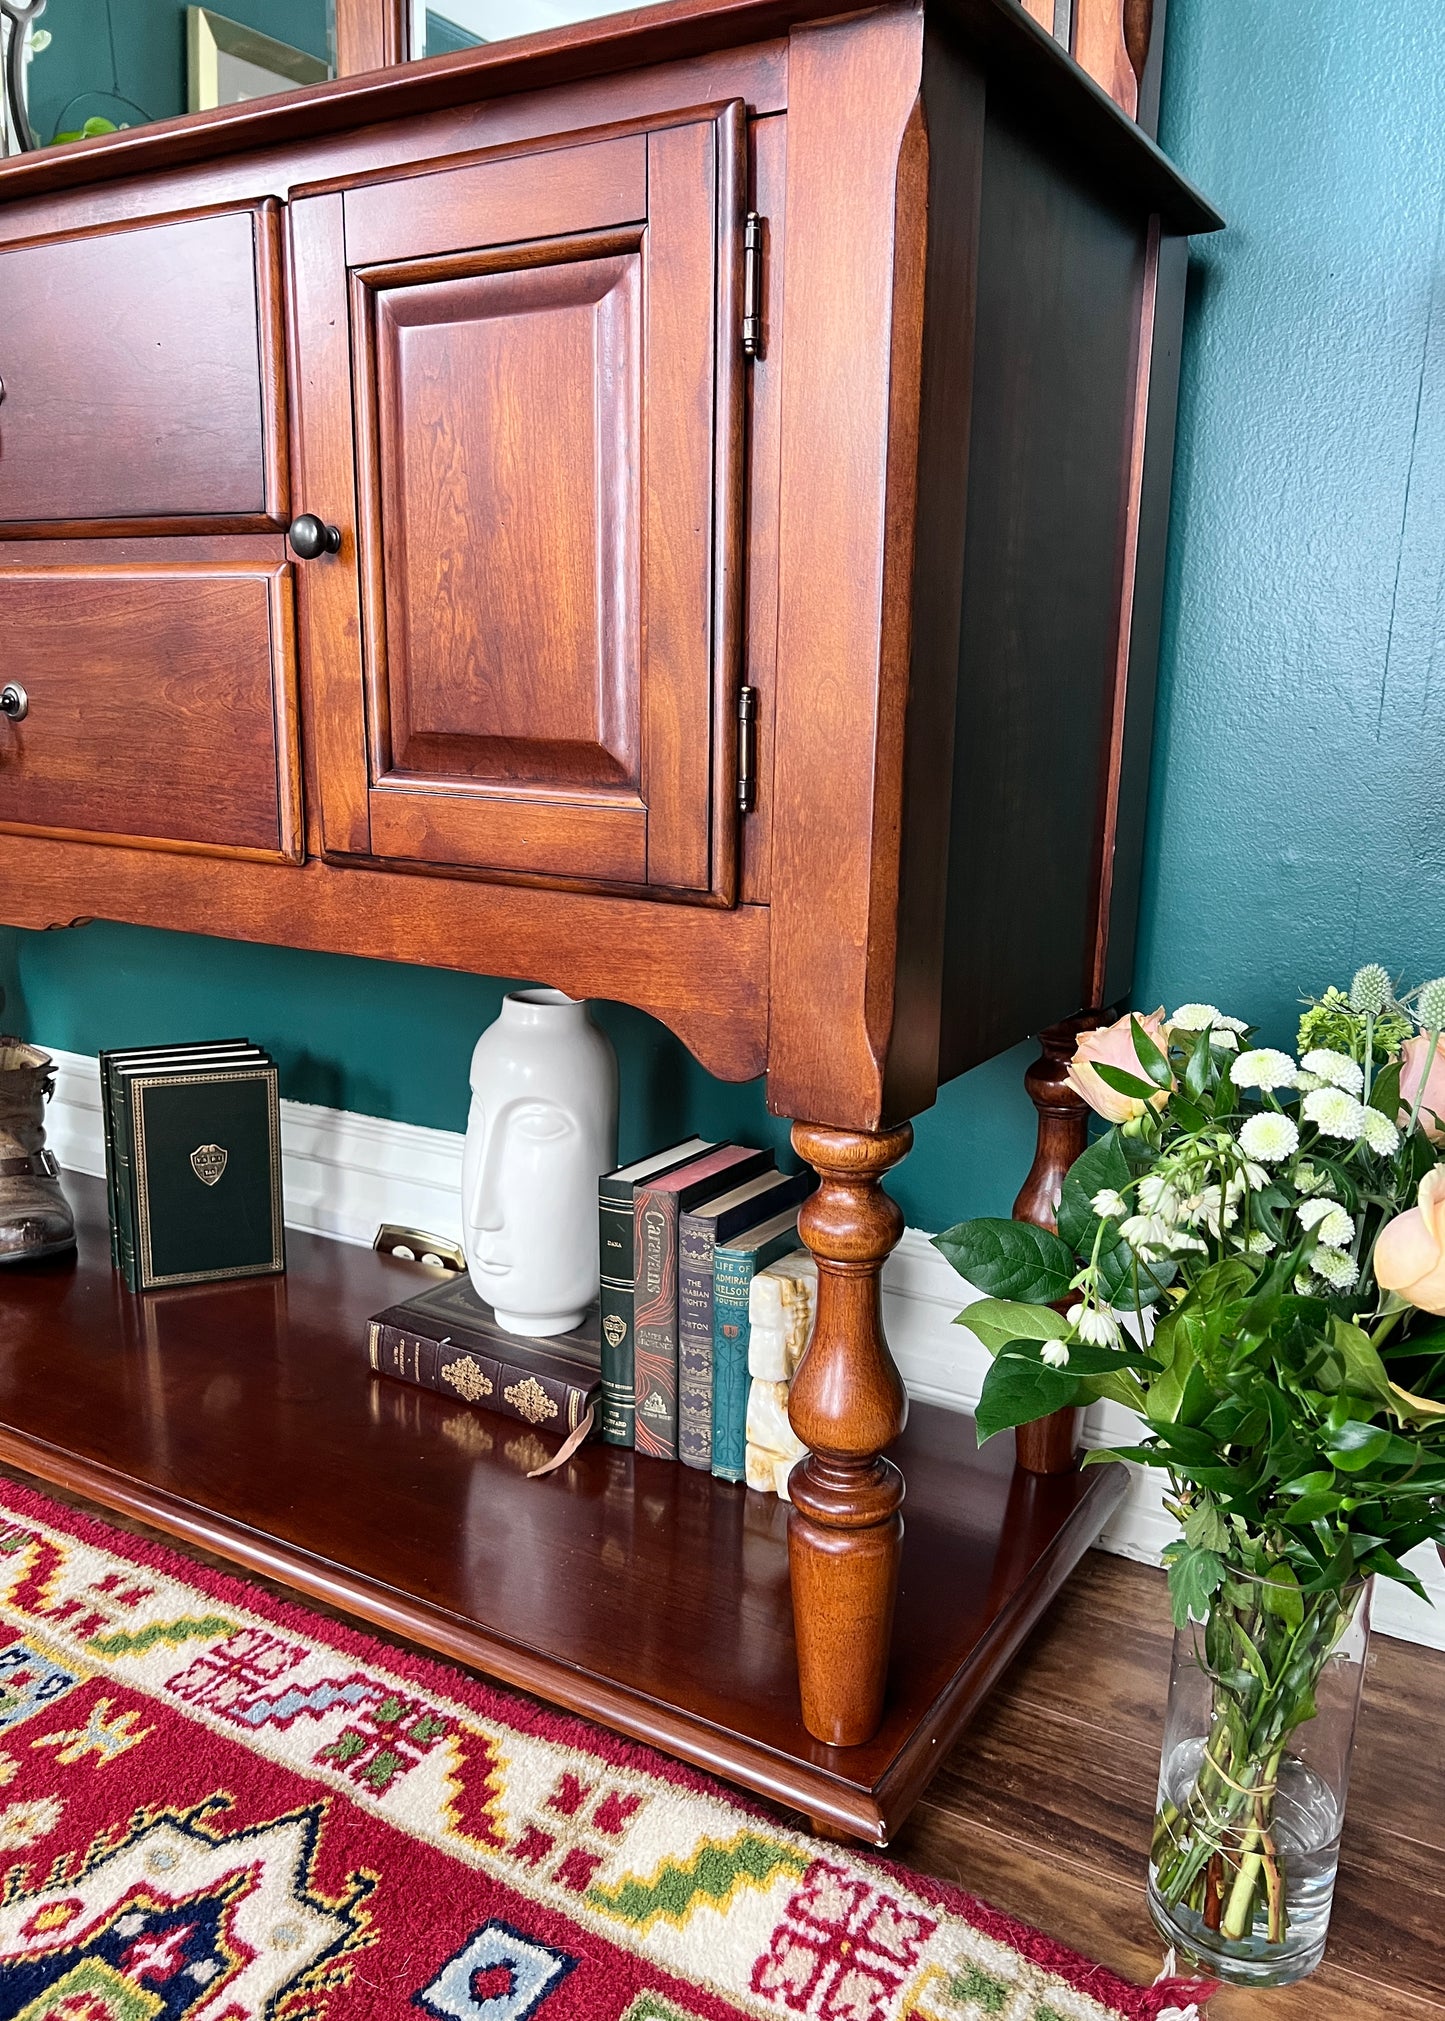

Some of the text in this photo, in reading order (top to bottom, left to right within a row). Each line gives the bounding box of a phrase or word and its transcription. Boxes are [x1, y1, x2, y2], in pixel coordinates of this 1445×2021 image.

[645, 1210, 665, 1294] Caravans
[715, 1260, 751, 1273] LIFE OF
[687, 1278, 702, 1288] THE
[715, 1273, 750, 1285] ADMIRAL
[715, 1283, 749, 1296] NELSON
